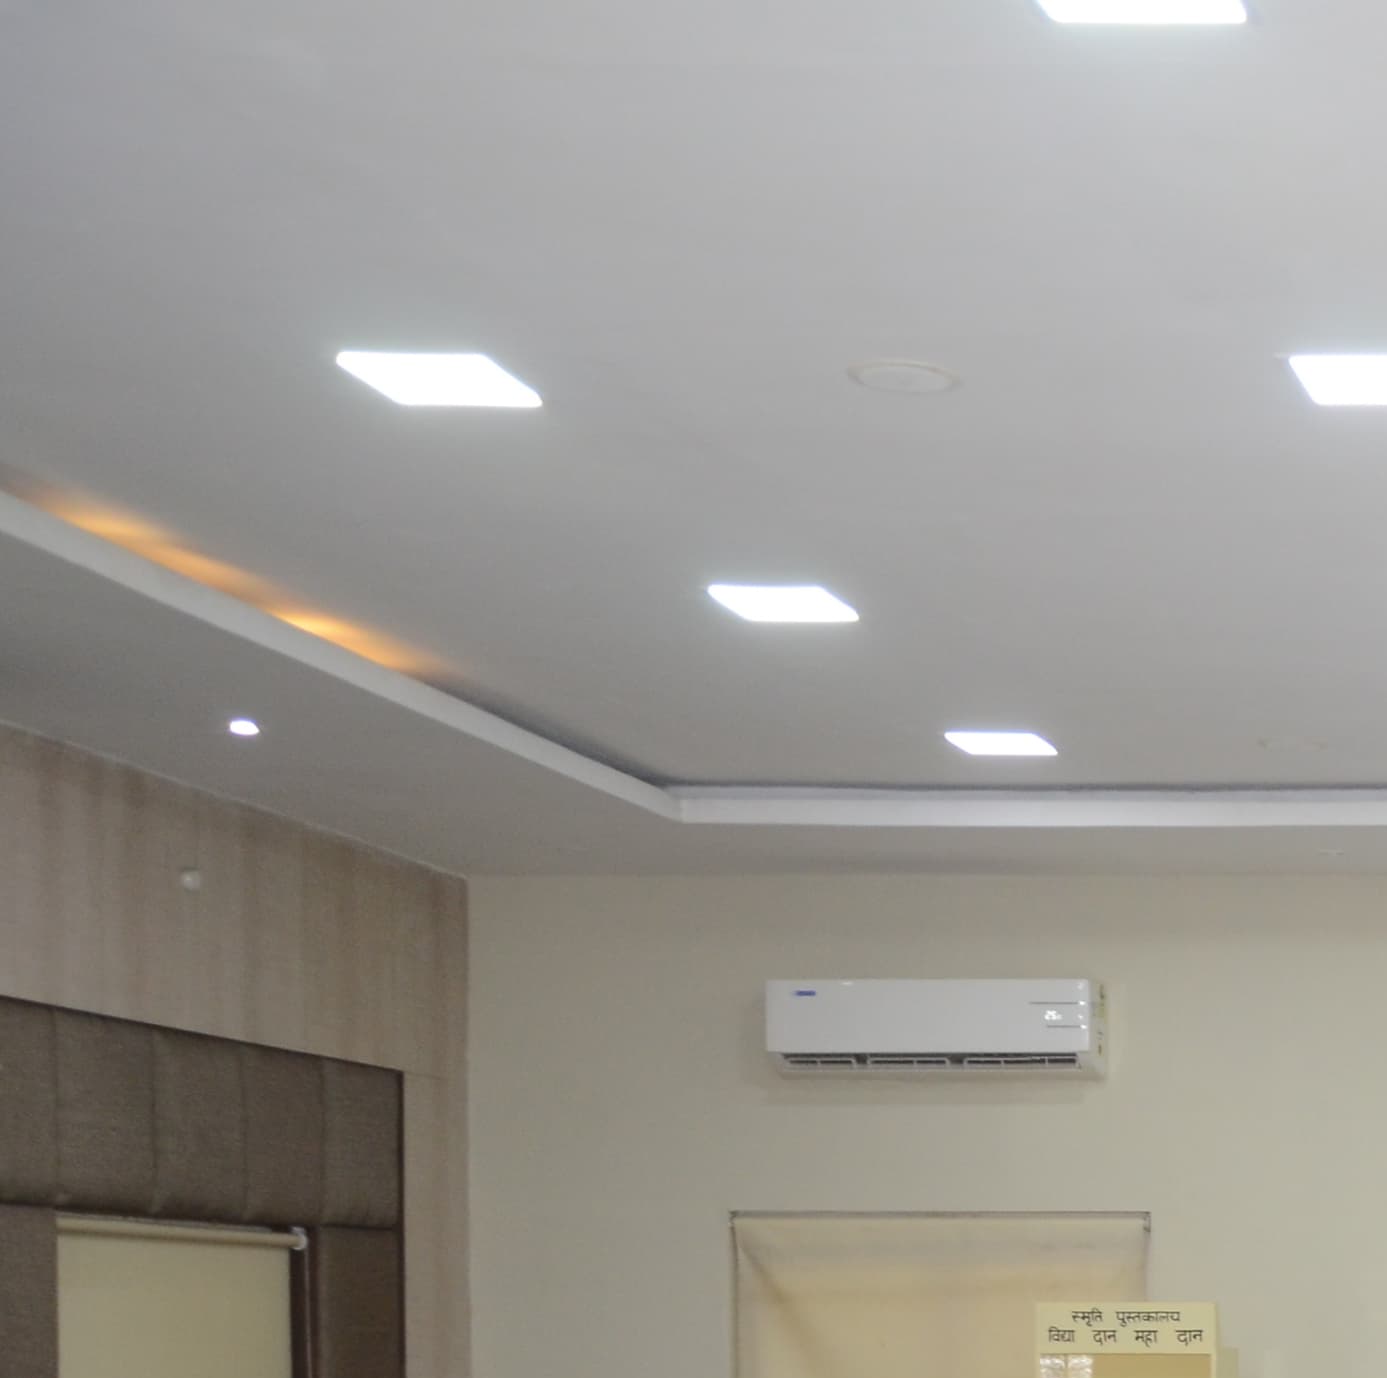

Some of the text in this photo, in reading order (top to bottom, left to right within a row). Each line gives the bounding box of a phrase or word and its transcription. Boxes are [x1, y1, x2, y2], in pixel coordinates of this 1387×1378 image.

[1071, 1308, 1103, 1326] स्मृति
[1048, 1326, 1204, 1347] विद्या दान महा दान
